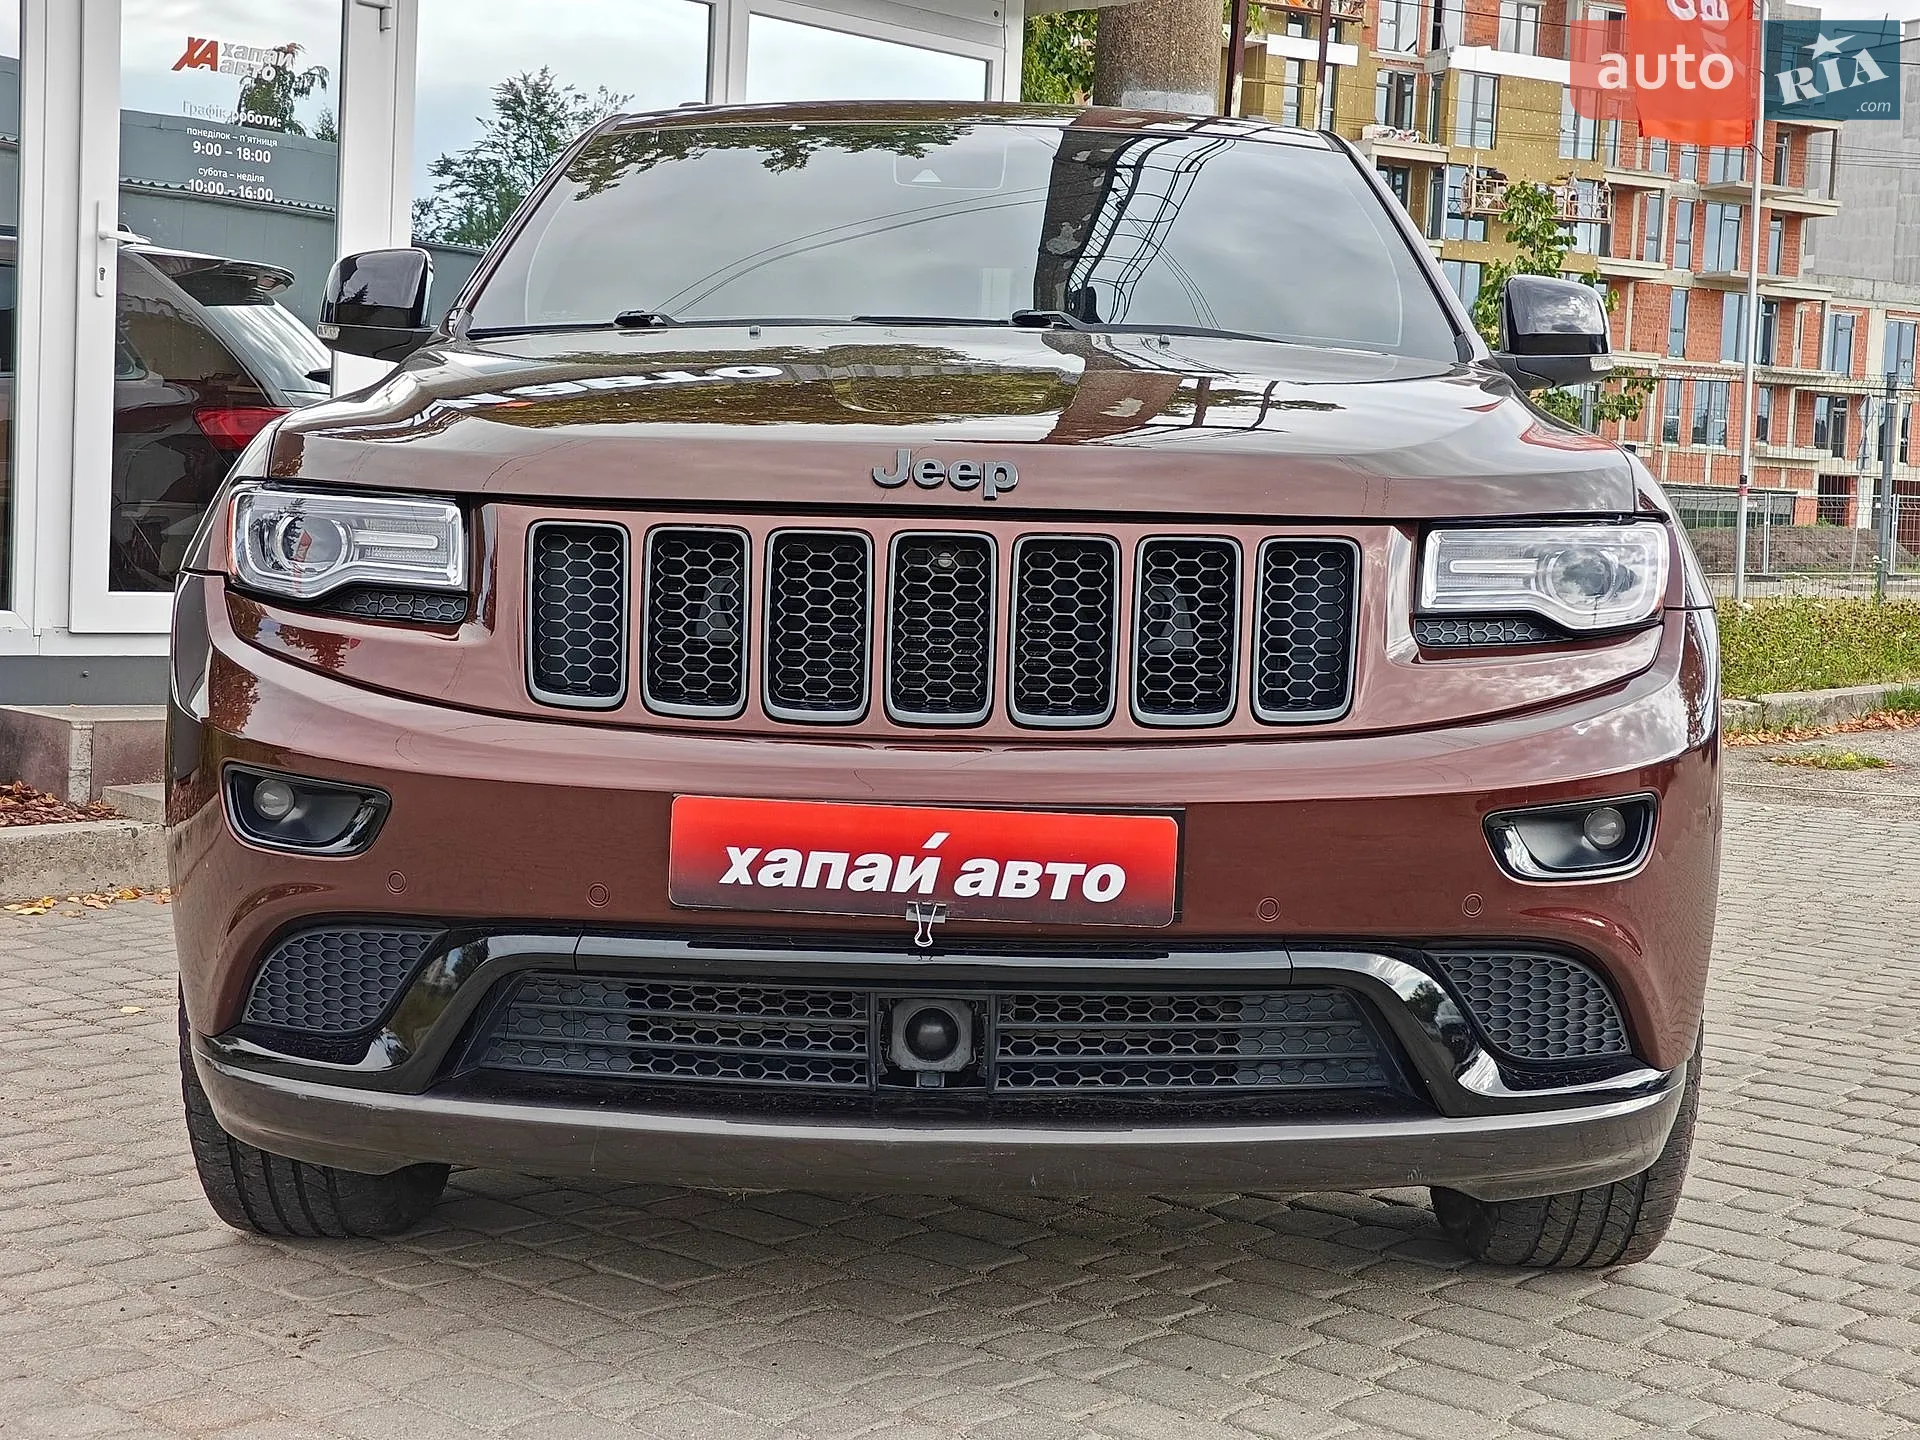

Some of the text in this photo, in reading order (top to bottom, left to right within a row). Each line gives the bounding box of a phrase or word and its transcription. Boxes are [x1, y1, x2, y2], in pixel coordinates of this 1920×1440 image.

[219, 59, 276, 81] авто
[182, 100, 282, 127] Графік роботи:
[186, 127, 231, 140] понеділок
[192, 140, 222, 157] 9:00
[236, 146, 271, 163] 18:00
[198, 167, 228, 178] субота
[236, 172, 265, 183] неділя
[188, 178, 225, 195] 10:00
[238, 185, 273, 201] 16:00
[871, 448, 1019, 501] Jeep
[953, 857, 1127, 902] авто
